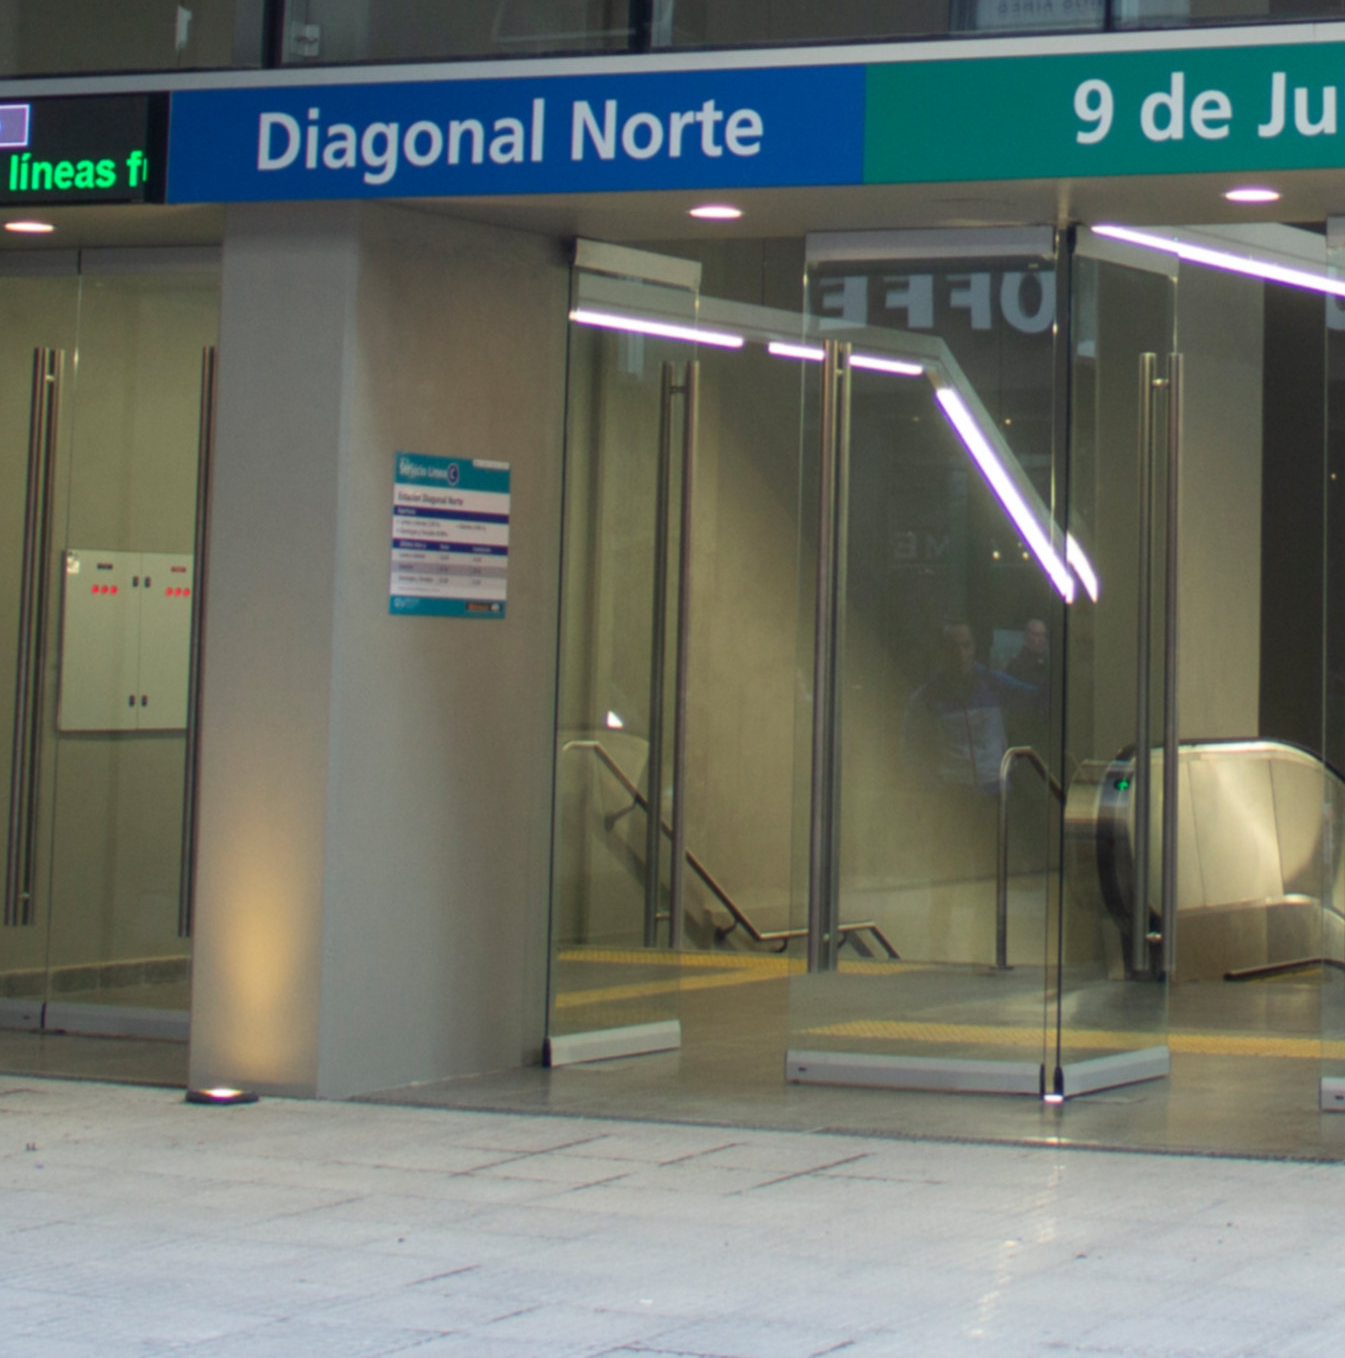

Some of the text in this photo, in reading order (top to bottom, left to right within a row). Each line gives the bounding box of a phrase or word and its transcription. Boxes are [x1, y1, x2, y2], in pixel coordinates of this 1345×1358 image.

[257, 98, 765, 185] Diagonal Norte
[1072, 78, 1115, 144] 9
[1139, 71, 1233, 141] de
[9, 153, 117, 191] líneas
